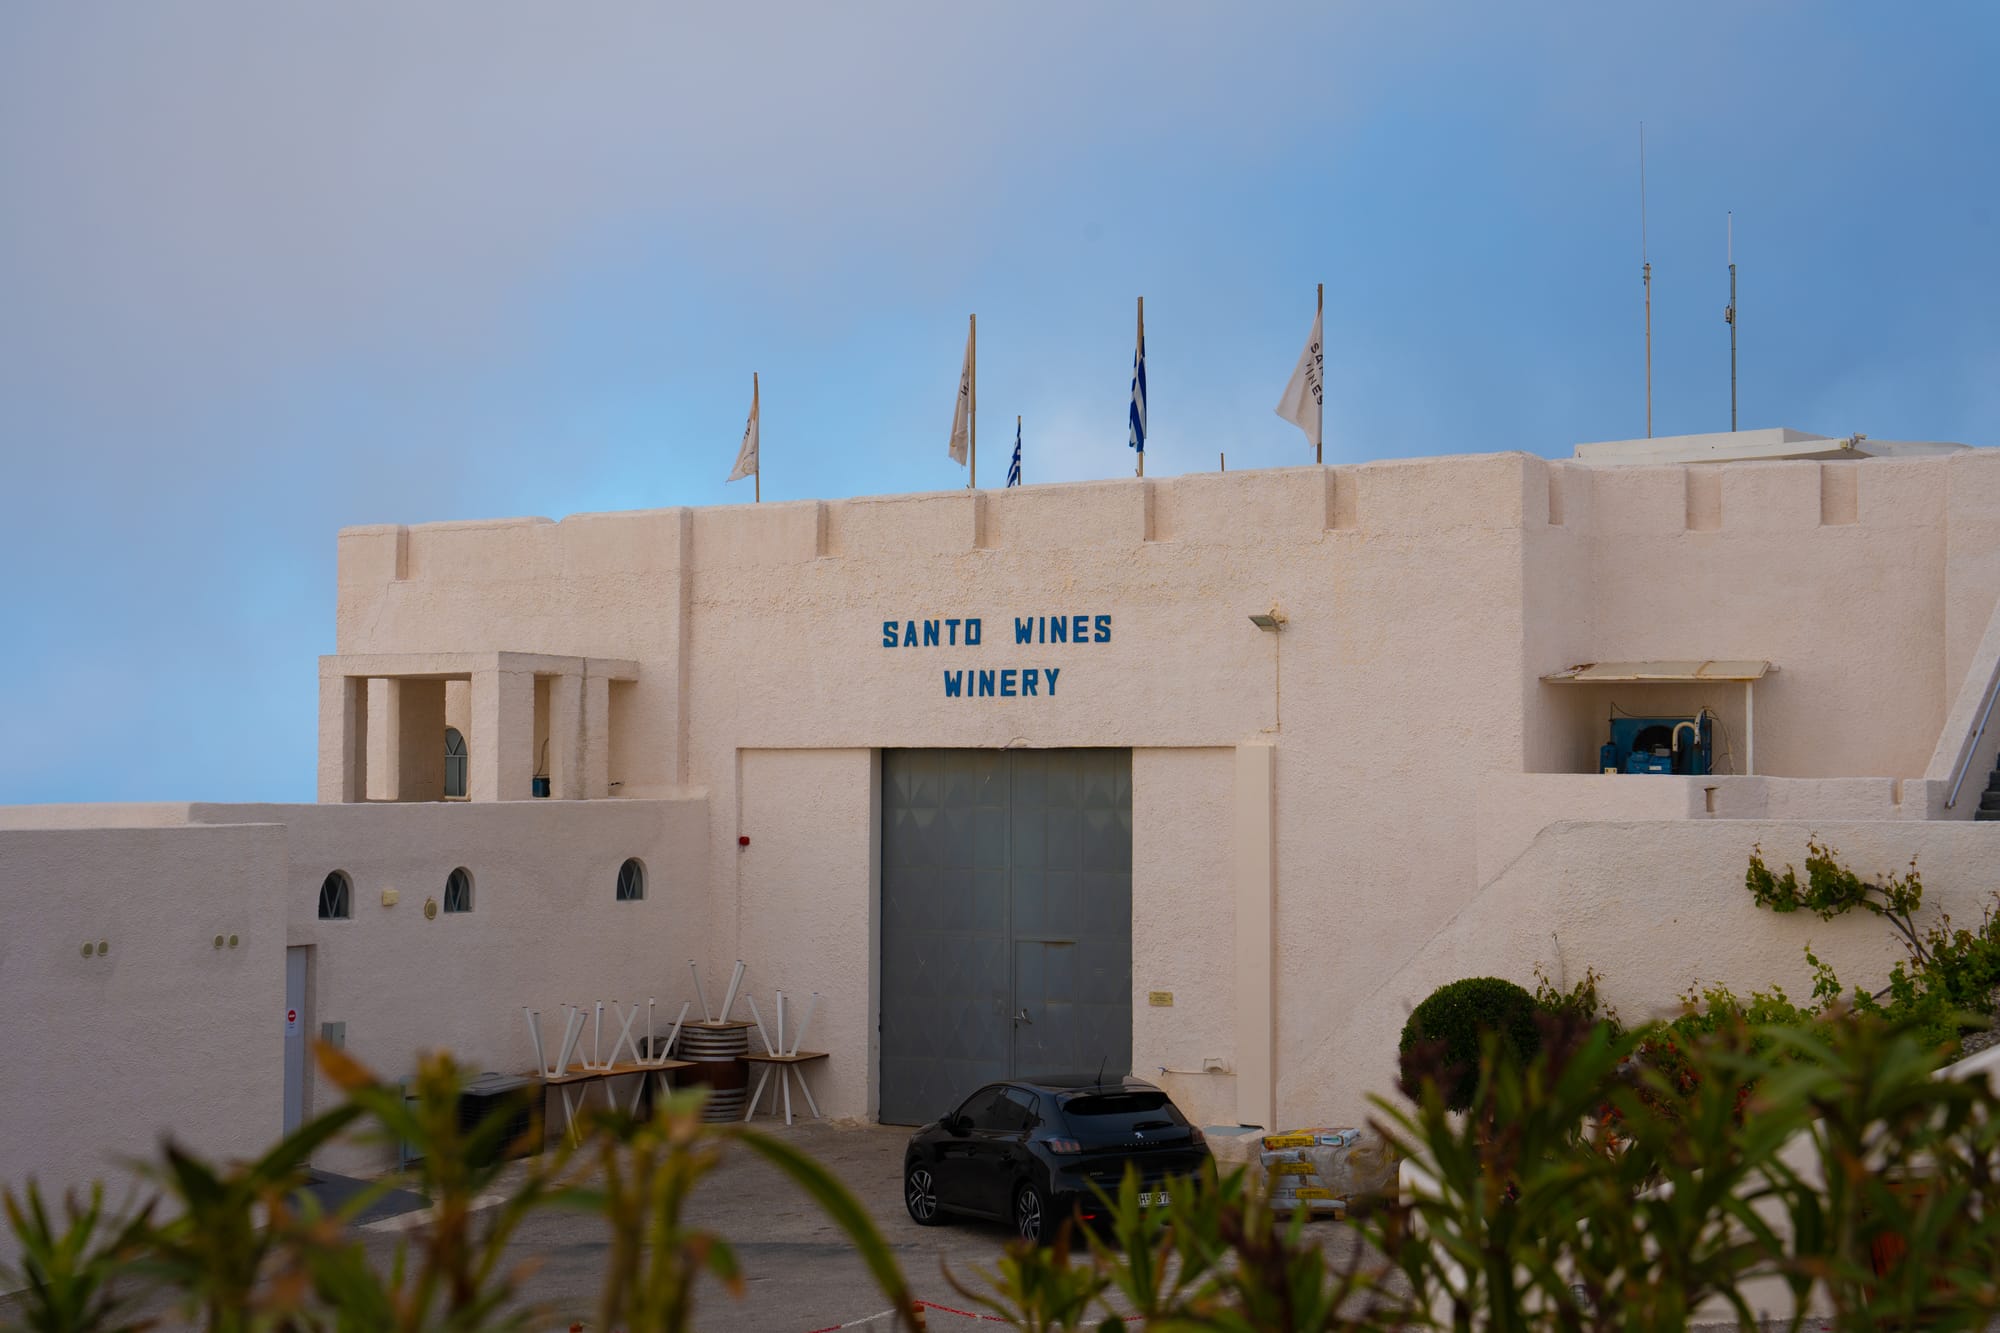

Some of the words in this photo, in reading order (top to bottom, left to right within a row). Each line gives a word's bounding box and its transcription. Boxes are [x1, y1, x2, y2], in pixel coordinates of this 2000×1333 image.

[1305, 363, 1323, 406] INES
[883, 618, 982, 648] SANTO
[1014, 615, 1112, 644] WINES
[943, 668, 1060, 698] WINERY
